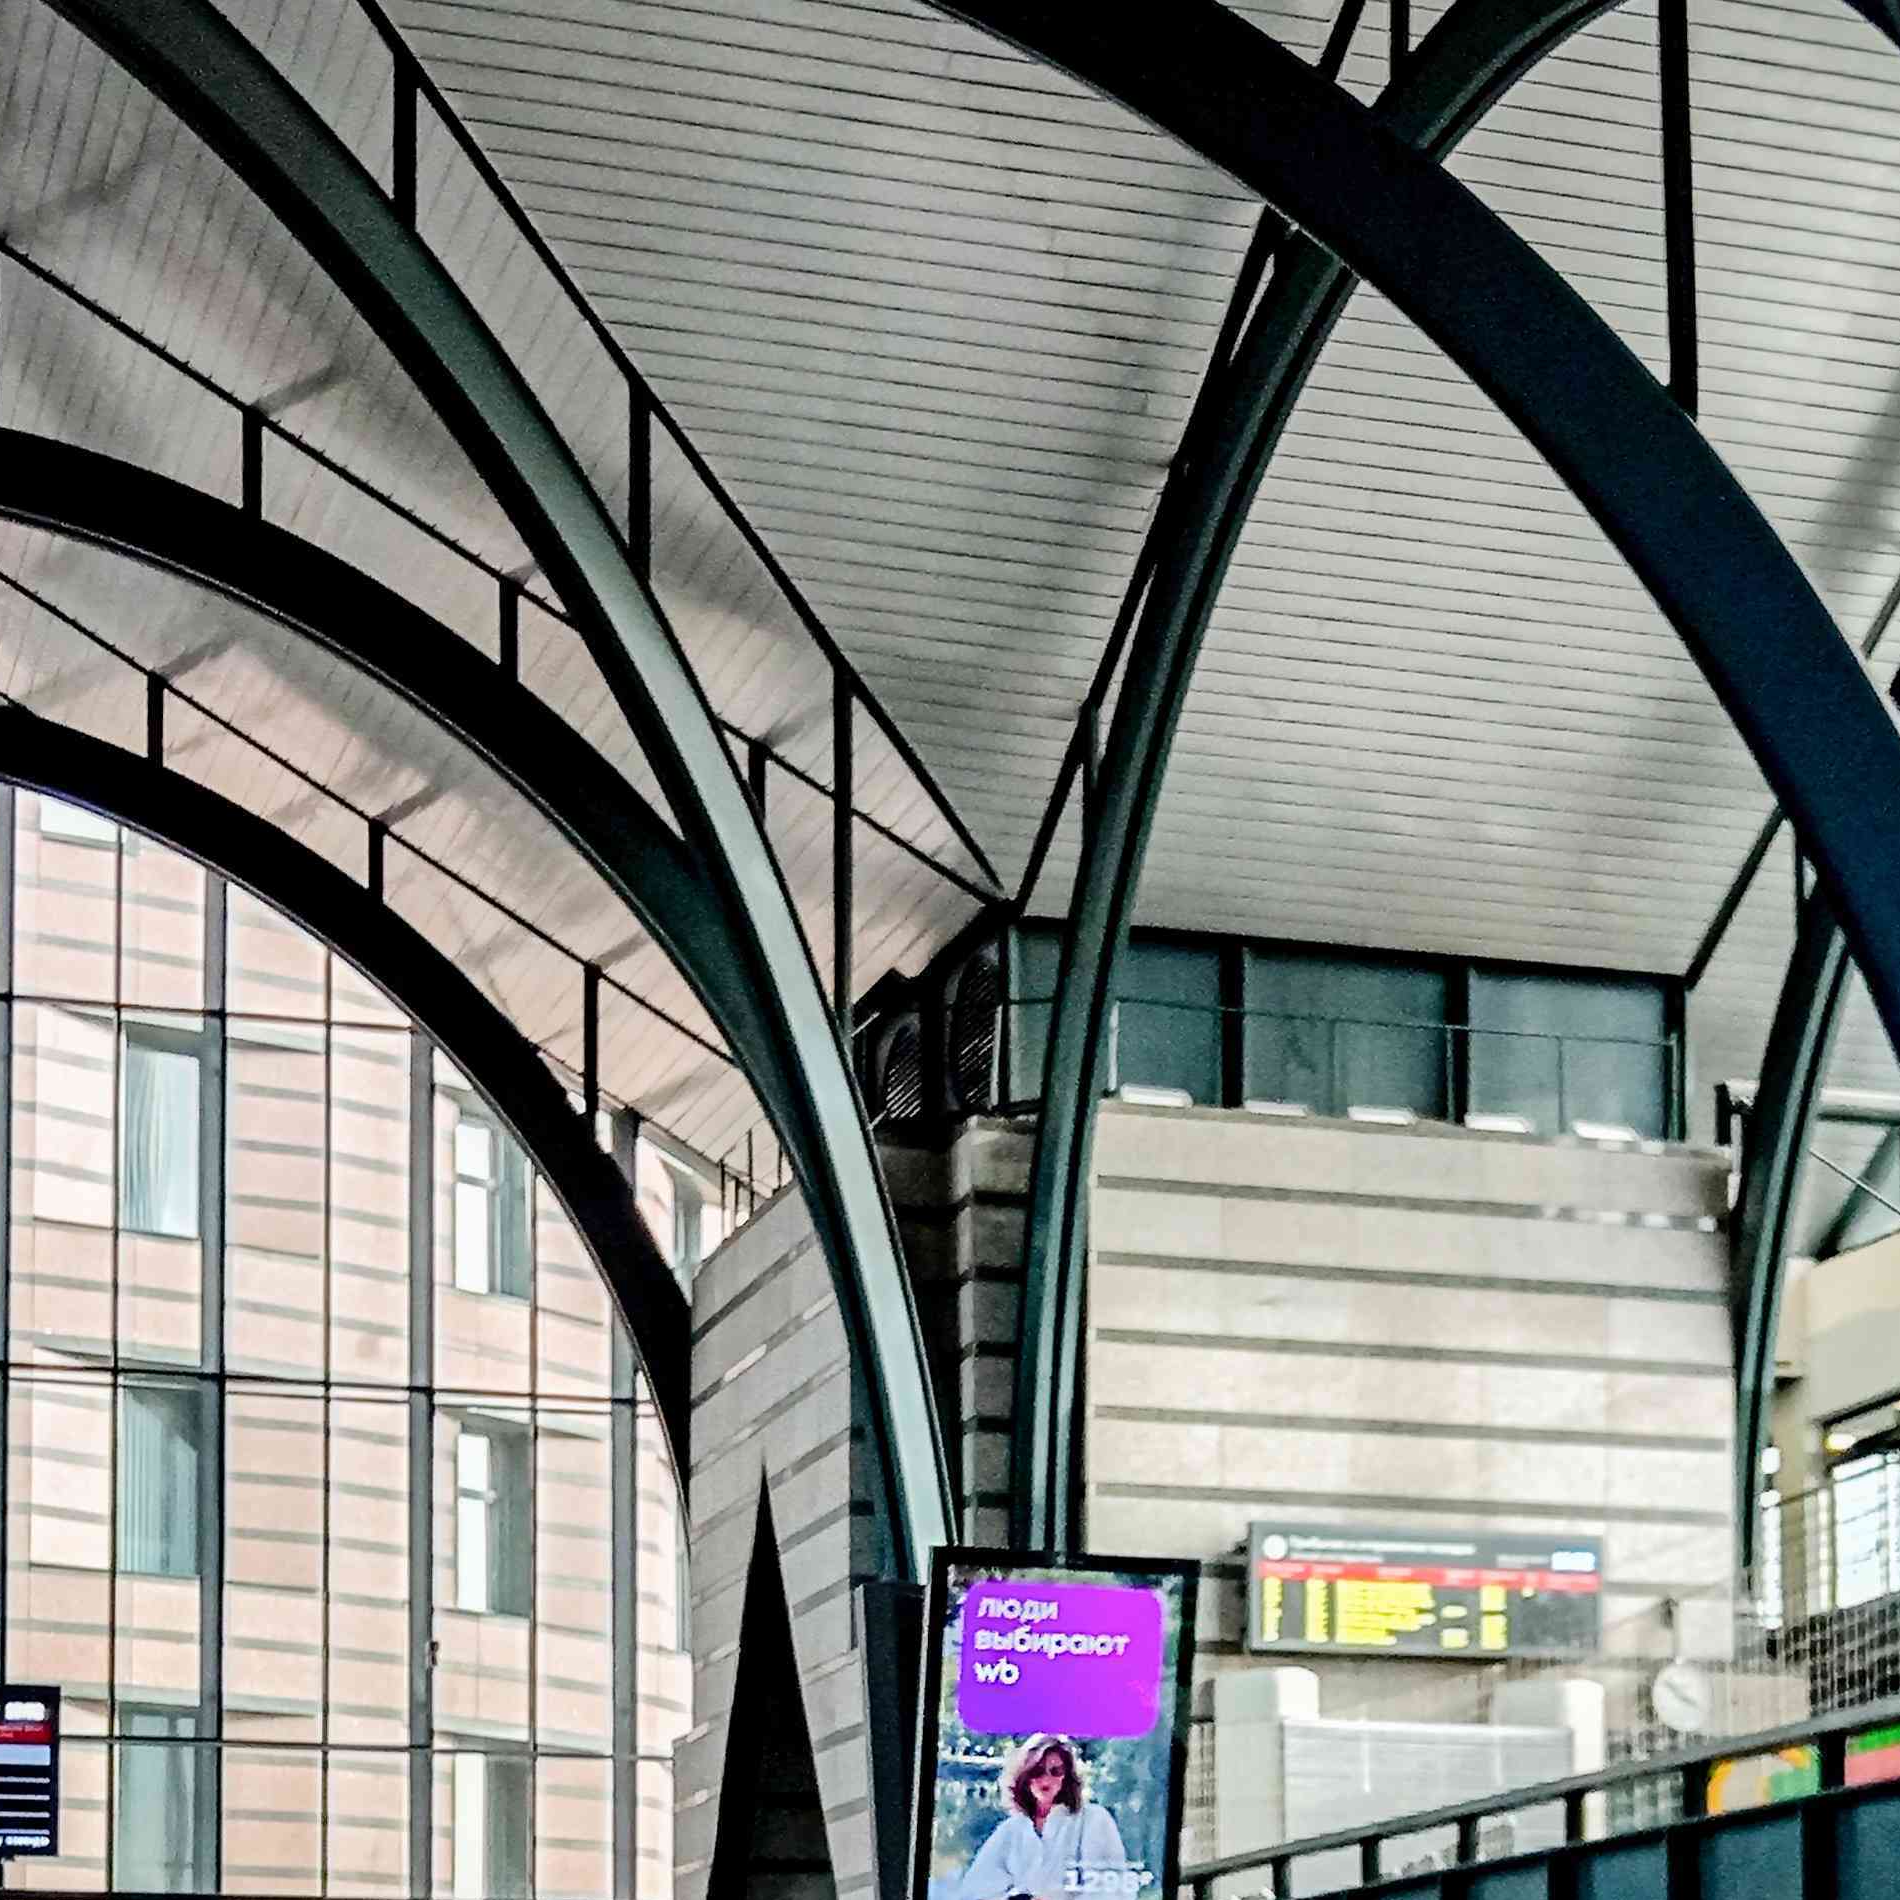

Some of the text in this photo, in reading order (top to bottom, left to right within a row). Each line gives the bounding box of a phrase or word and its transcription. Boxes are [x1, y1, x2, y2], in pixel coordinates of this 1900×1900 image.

[978, 1597, 1059, 1623] люди
[975, 1625, 1131, 1660] выбирают
[972, 1656, 1020, 1685] wb
